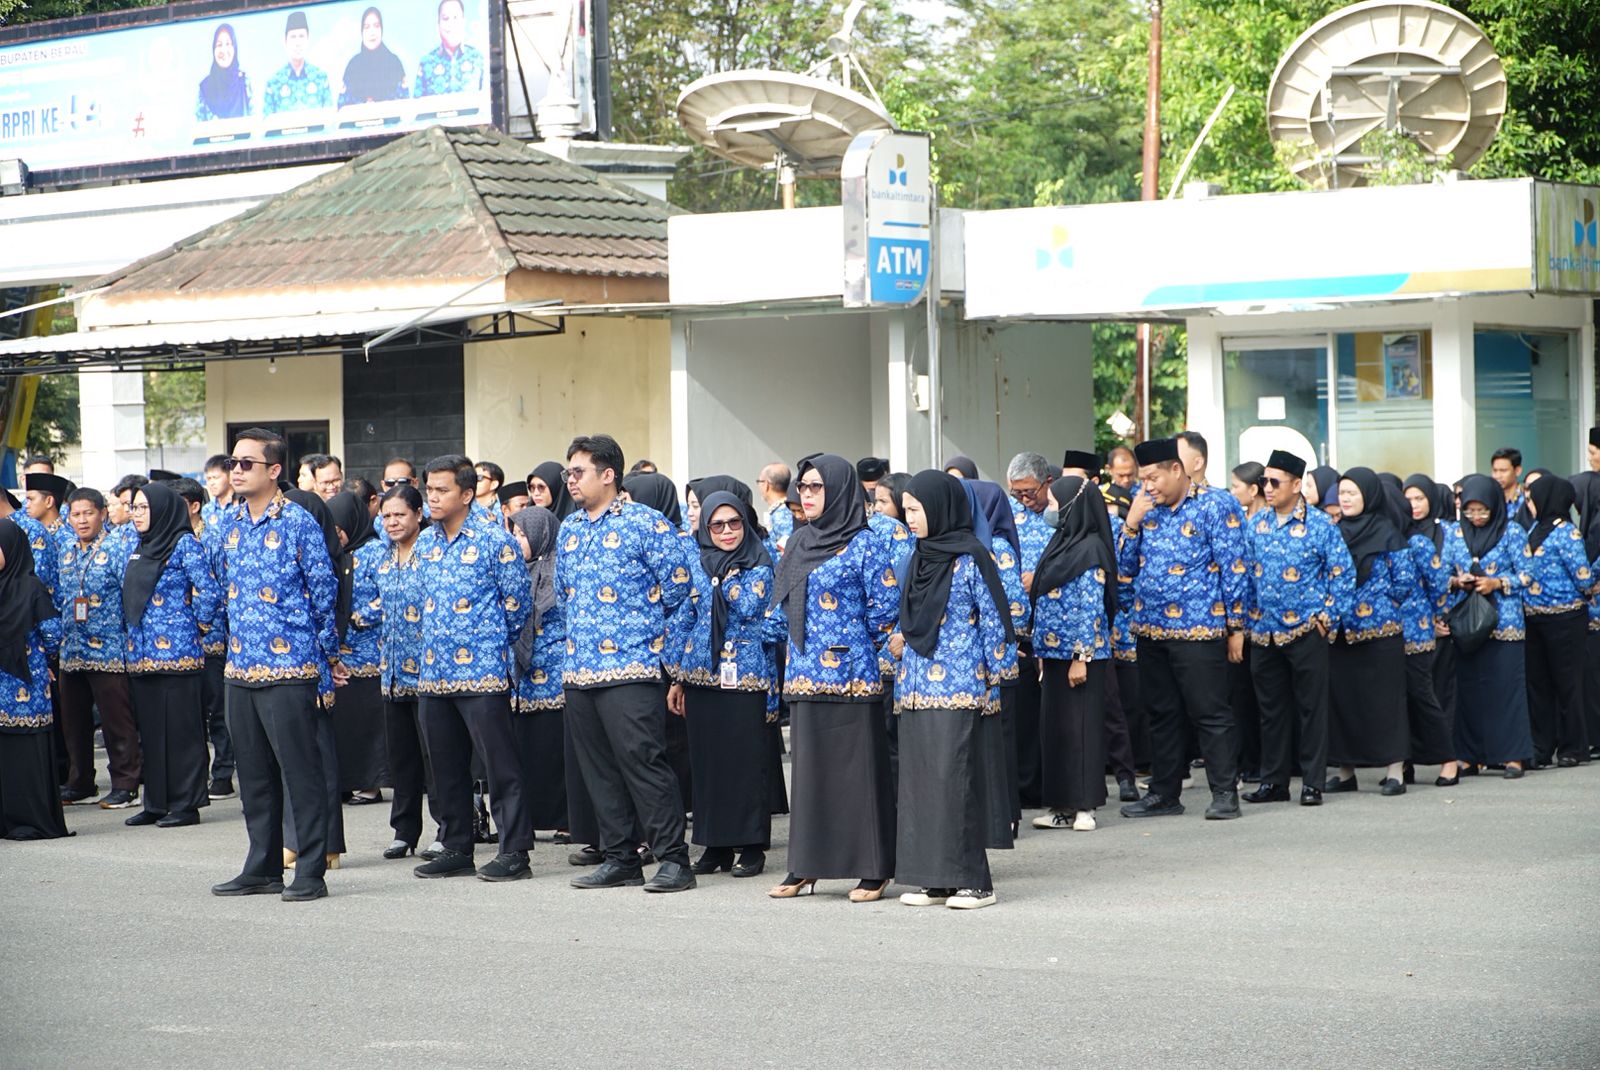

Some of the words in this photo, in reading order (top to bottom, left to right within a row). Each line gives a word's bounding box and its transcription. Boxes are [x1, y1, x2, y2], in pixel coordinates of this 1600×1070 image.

[2, 109, 35, 138] RPRI
[872, 188, 925, 203] bankaltimtara
[877, 246, 922, 276] ATM
